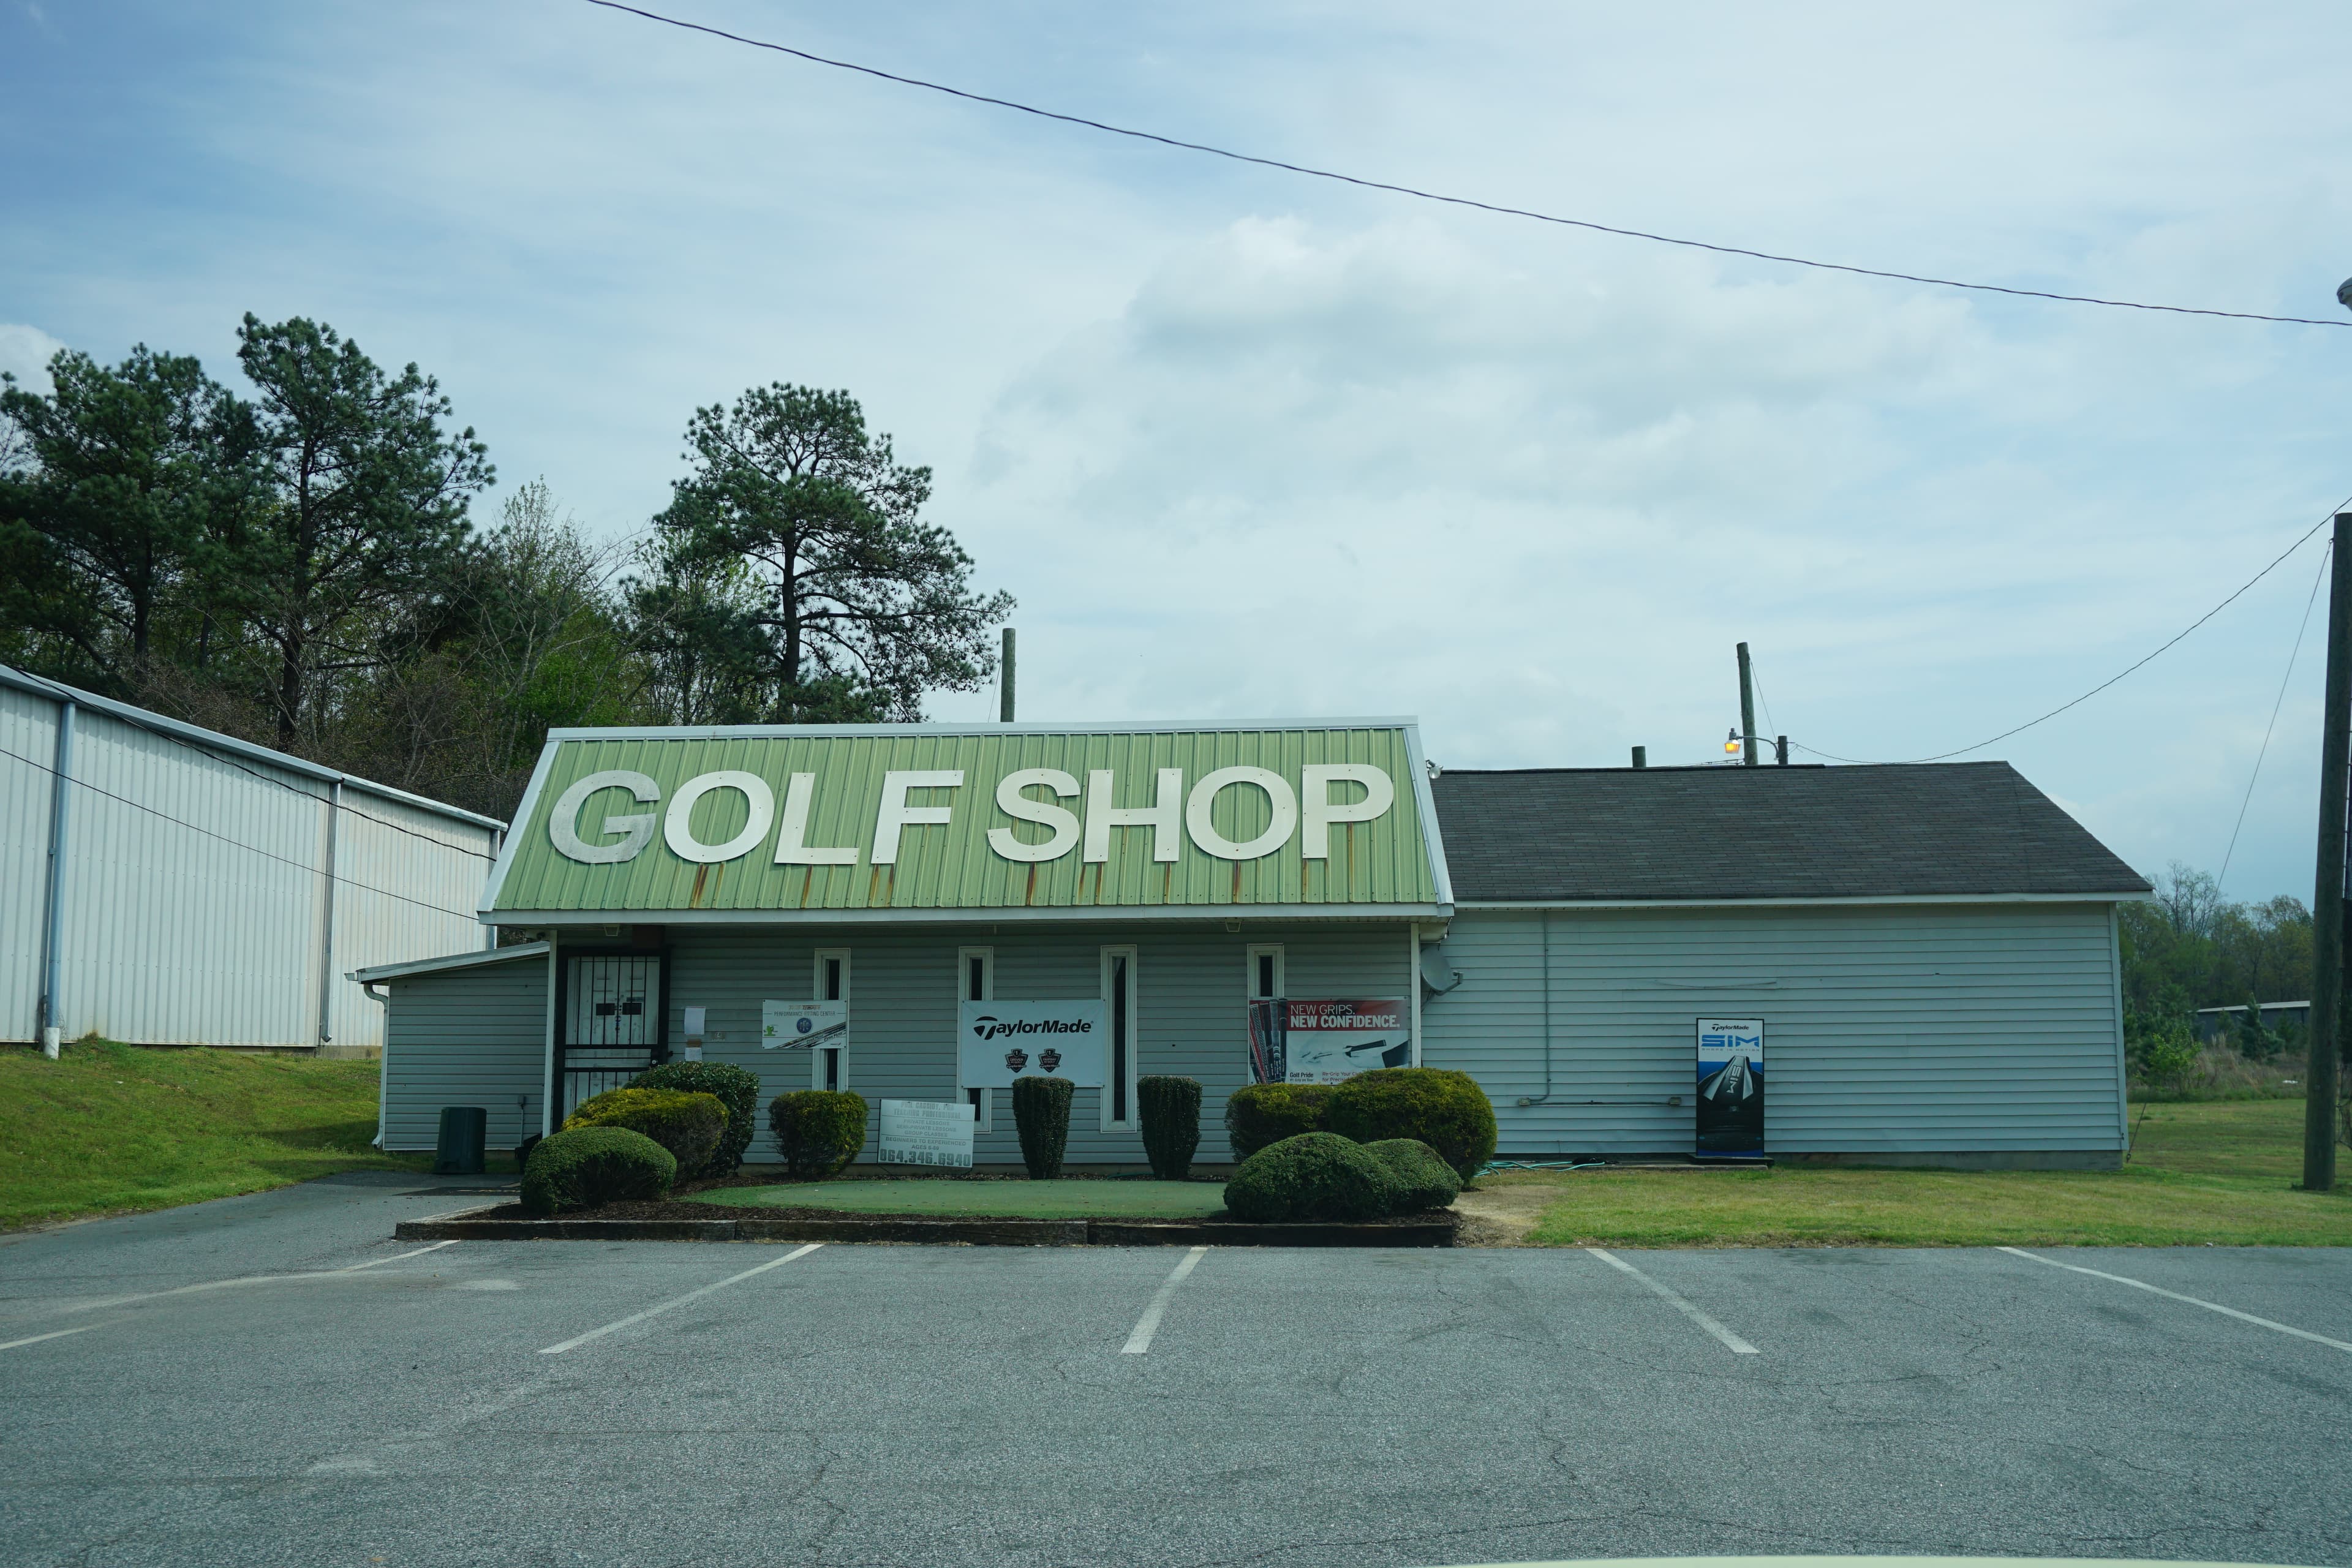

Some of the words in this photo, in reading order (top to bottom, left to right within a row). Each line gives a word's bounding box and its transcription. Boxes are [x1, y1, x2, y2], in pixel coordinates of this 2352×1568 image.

[548, 769, 965, 865] GOLF
[987, 763, 1395, 863] SHOP
[1290, 1005, 1317, 1015] NEW
[1319, 1005, 1355, 1015] GRIPS.
[973, 1016, 1092, 1040] TaylorMade
[1291, 1016, 1317, 1028] NEW
[1321, 1014, 1400, 1028] CONFIDENCE.
[1701, 1035, 1760, 1047] SIM
